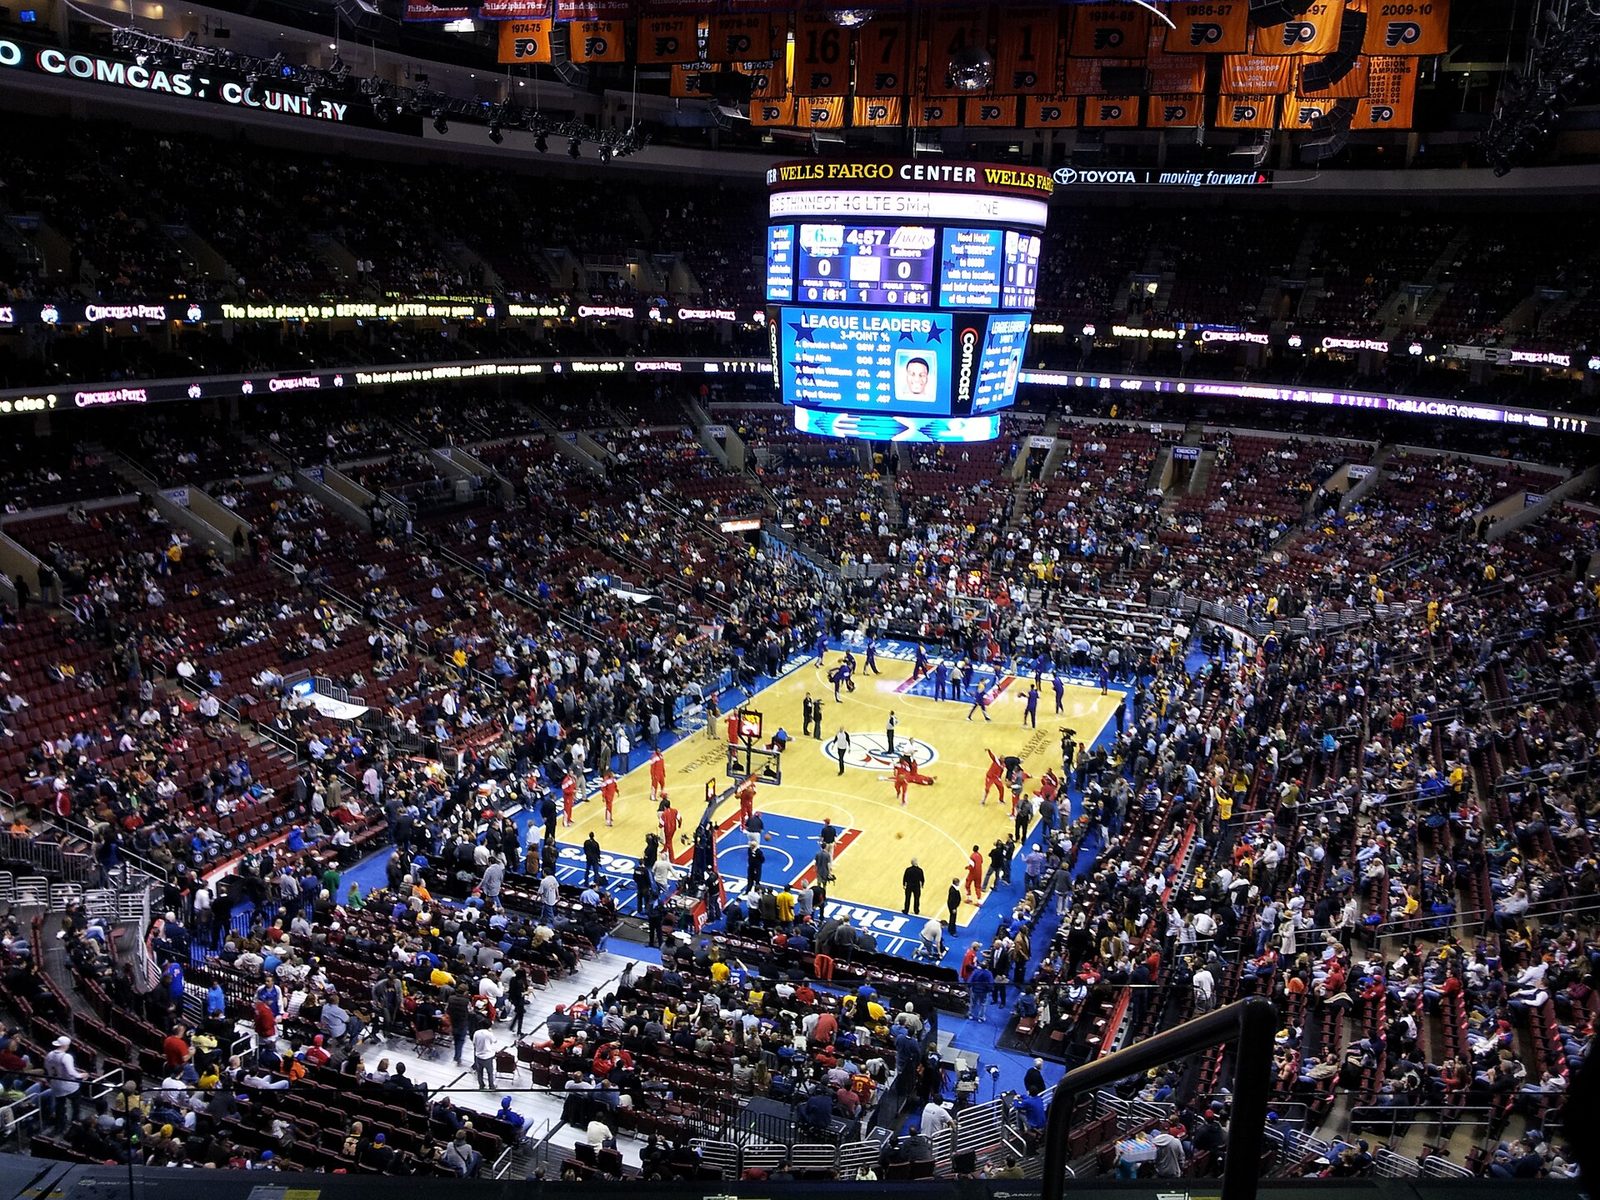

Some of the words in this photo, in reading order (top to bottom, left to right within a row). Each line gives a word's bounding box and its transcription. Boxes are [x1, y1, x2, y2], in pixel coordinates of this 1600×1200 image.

[1186, 4, 1233, 16] 1986-87
[1382, 4, 1433, 17] 2009-10
[512, 23, 541, 34] 1974-75
[804, 29, 840, 65] 16
[878, 27, 899, 65] 7
[779, 167, 825, 181] WELLS
[828, 163, 894, 179] FARGO
[900, 164, 977, 183] CENTER
[984, 168, 1035, 189] WELLS
[1079, 170, 1136, 184] TOYOTA
[1159, 171, 1203, 187] moving
[1206, 169, 1257, 186] forward
[865, 196, 892, 211] LTE
[846, 229, 886, 245] 4:57
[858, 245, 873, 256] 24
[817, 259, 832, 276] 0
[897, 261, 912, 279] 0
[807, 288, 818, 300] 0
[887, 290, 898, 304] 0
[139, 305, 166, 320] PETE'S
[221, 304, 244, 319] The
[247, 304, 273, 318] best
[276, 304, 306, 319] place
[308, 304, 320, 318] to
[321, 307, 334, 318] go
[336, 304, 377, 317] BEFORE
[378, 304, 396, 317] and
[397, 304, 427, 317] AFTER
[427, 306, 451, 318] every
[451, 306, 474, 318] game
[509, 304, 538, 317] Where
[539, 305, 558, 317] else
[559, 305, 567, 317] ?
[801, 314, 859, 330] LEAGUE
[863, 317, 932, 334] LEADERS
[1032, 323, 1064, 334] game
[840, 330, 879, 342] 3-POINT
[881, 332, 890, 343] %
[1112, 325, 1149, 338] Where
[1151, 328, 1176, 339] else
[1177, 329, 1187, 340] ?
[1245, 332, 1269, 344] PETE'S
[1321, 336, 1360, 350] CHICKIE'S
[1366, 339, 1388, 352] PETE'S
[1510, 349, 1543, 363] HICKIE'S
[356, 372, 372, 384] The
[373, 372, 390, 383] best
[391, 371, 412, 382] place
[412, 370, 422, 380] to
[422, 371, 432, 381] go
[433, 366, 461, 379] BEFORE
[461, 366, 474, 377] and
[474, 364, 496, 376] AFTER
[497, 365, 519, 376] every
[520, 363, 542, 374] game
[572, 361, 597, 372] Where
[599, 361, 618, 372] else
[618, 361, 625, 372] ?
[14, 396, 45, 411] else
[46, 394, 57, 409] ?
[74, 391, 117, 407] CHICKIE'S
[121, 388, 147, 402] PETE'S
[1176, 447, 1197, 455] GEICO
